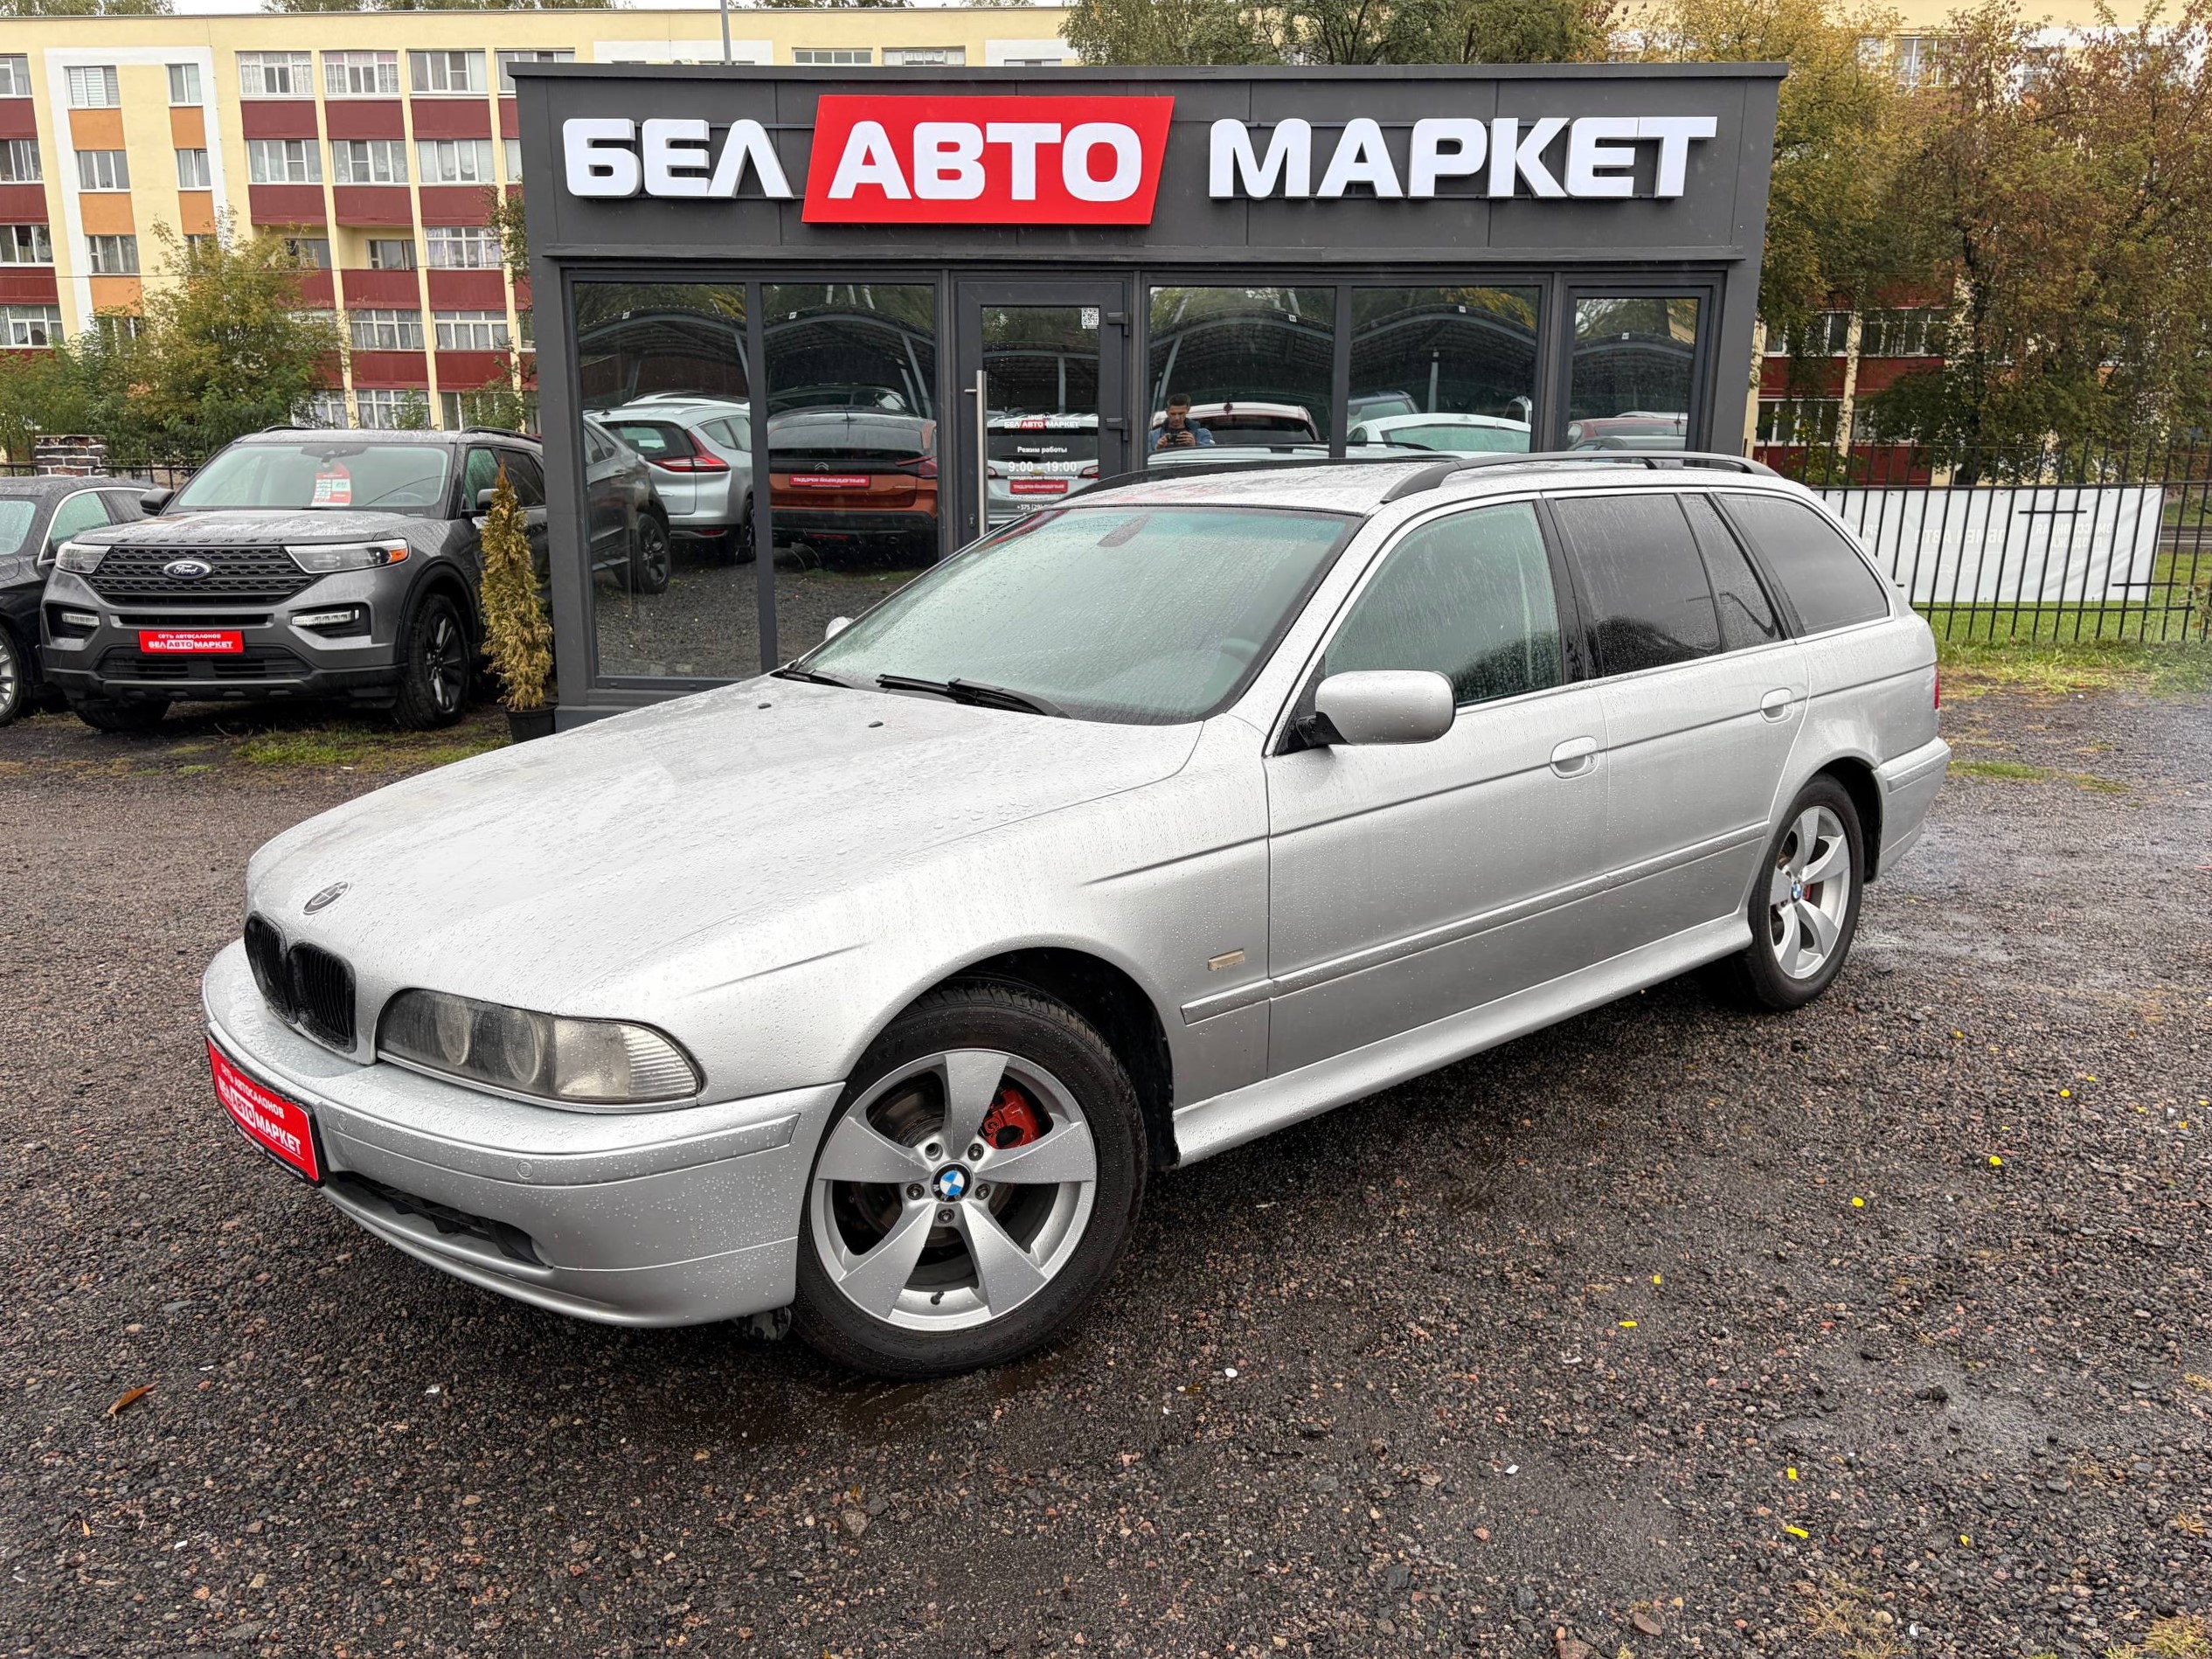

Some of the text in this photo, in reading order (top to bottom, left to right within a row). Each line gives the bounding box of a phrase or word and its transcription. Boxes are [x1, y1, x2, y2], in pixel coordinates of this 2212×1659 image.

[562, 115, 1718, 202] БЕЛ АВТО МАРКЕТ
[1008, 461, 1033, 472] 9:00
[1047, 461, 1078, 472] 19:00
[174, 564, 198, 574] Ford
